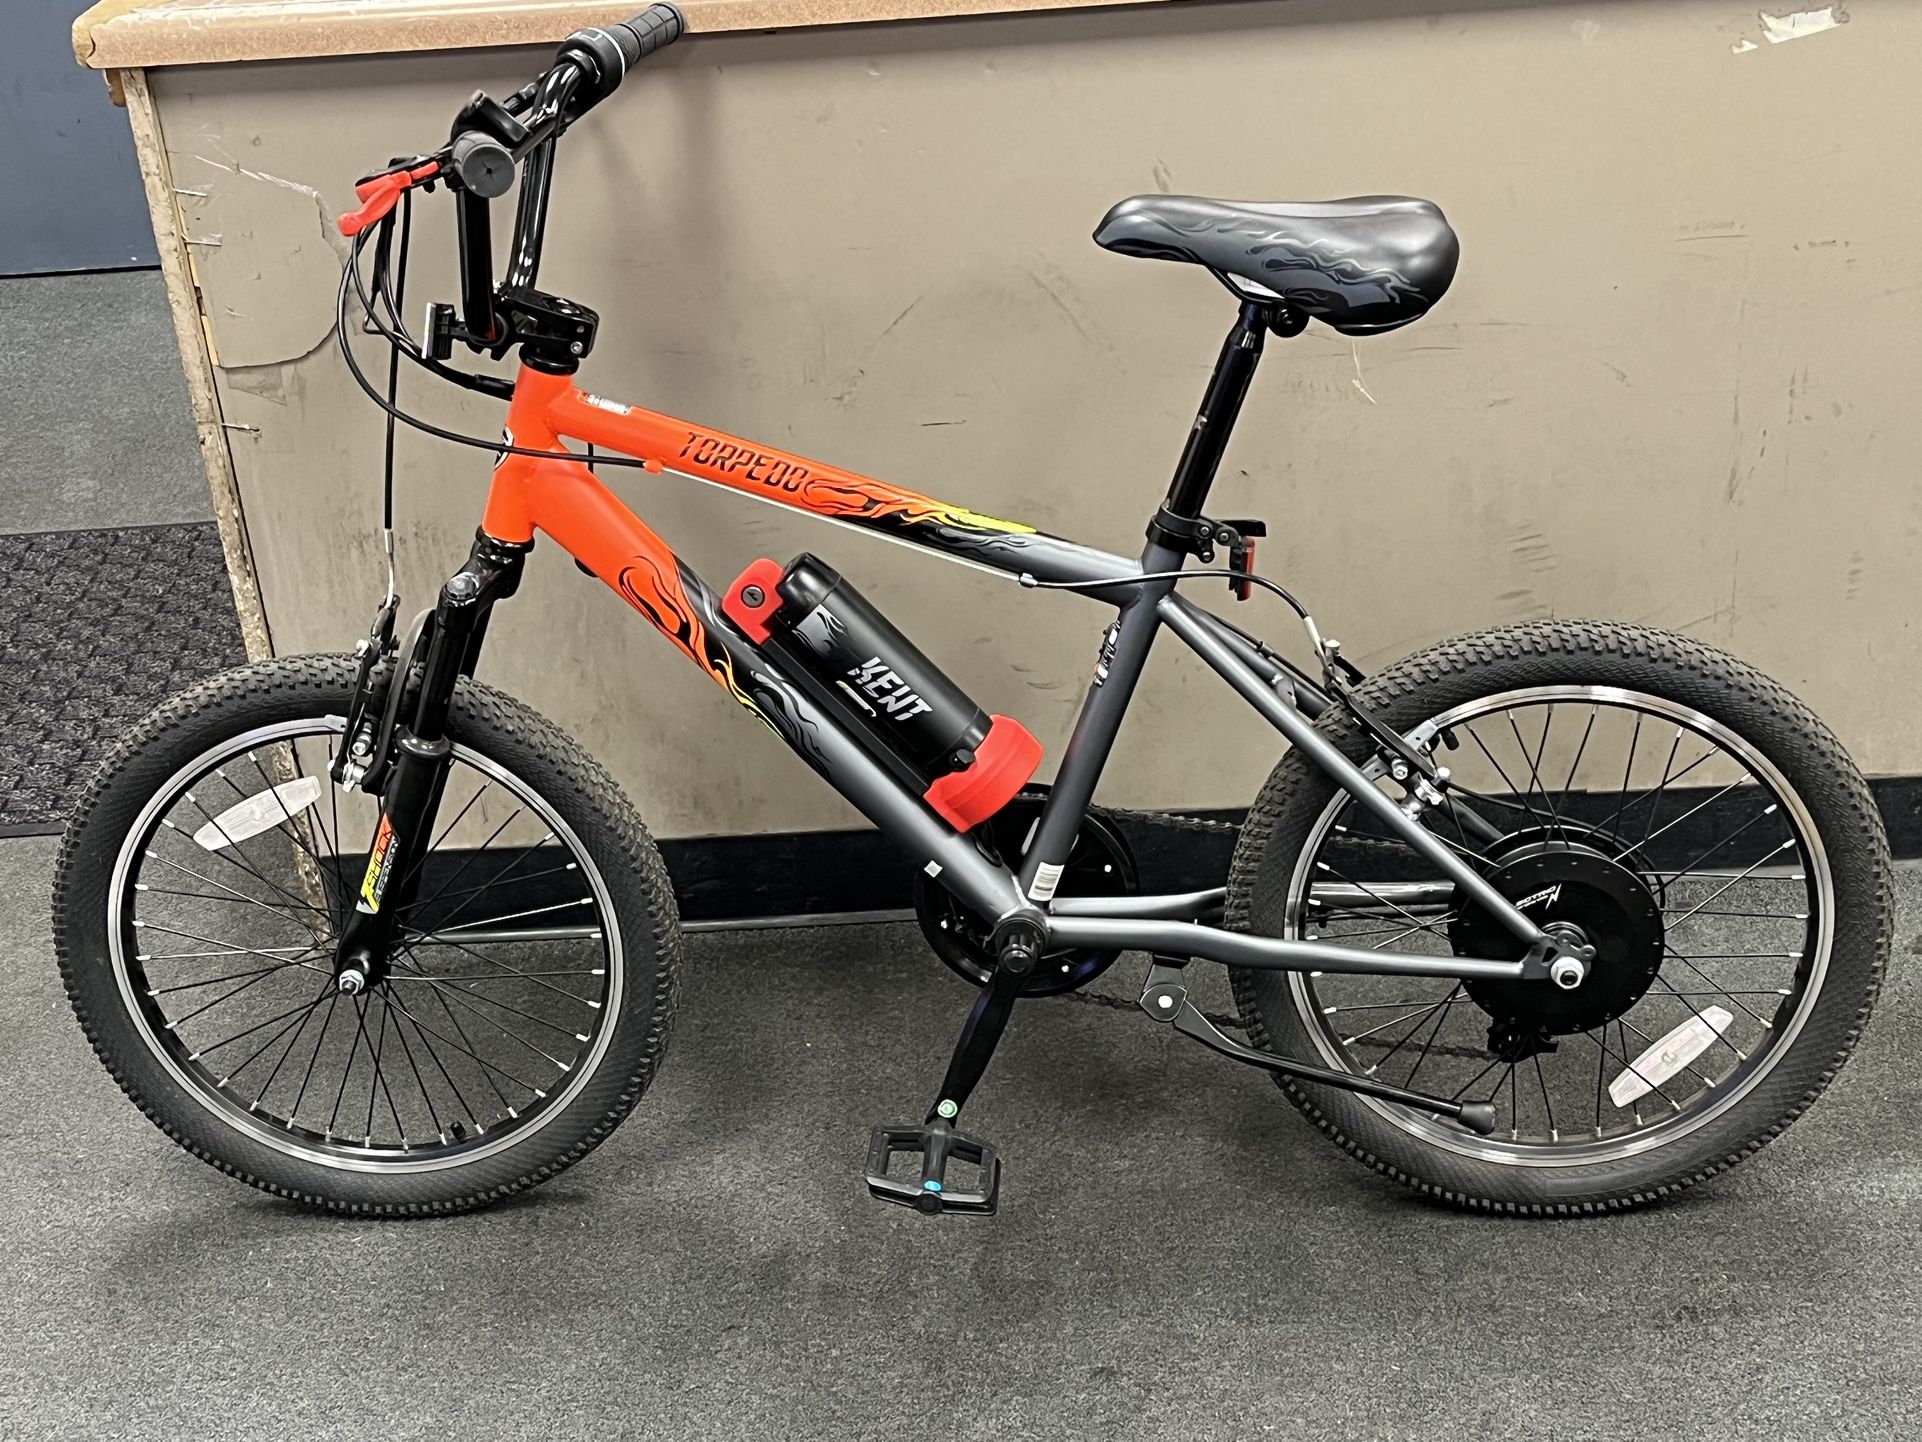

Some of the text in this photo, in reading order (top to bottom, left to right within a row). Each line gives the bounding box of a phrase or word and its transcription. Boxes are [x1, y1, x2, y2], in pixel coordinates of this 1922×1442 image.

[680, 431, 810, 493] TORPEDO
[847, 656, 933, 721] KENT
[367, 829, 393, 887] SHOCK
